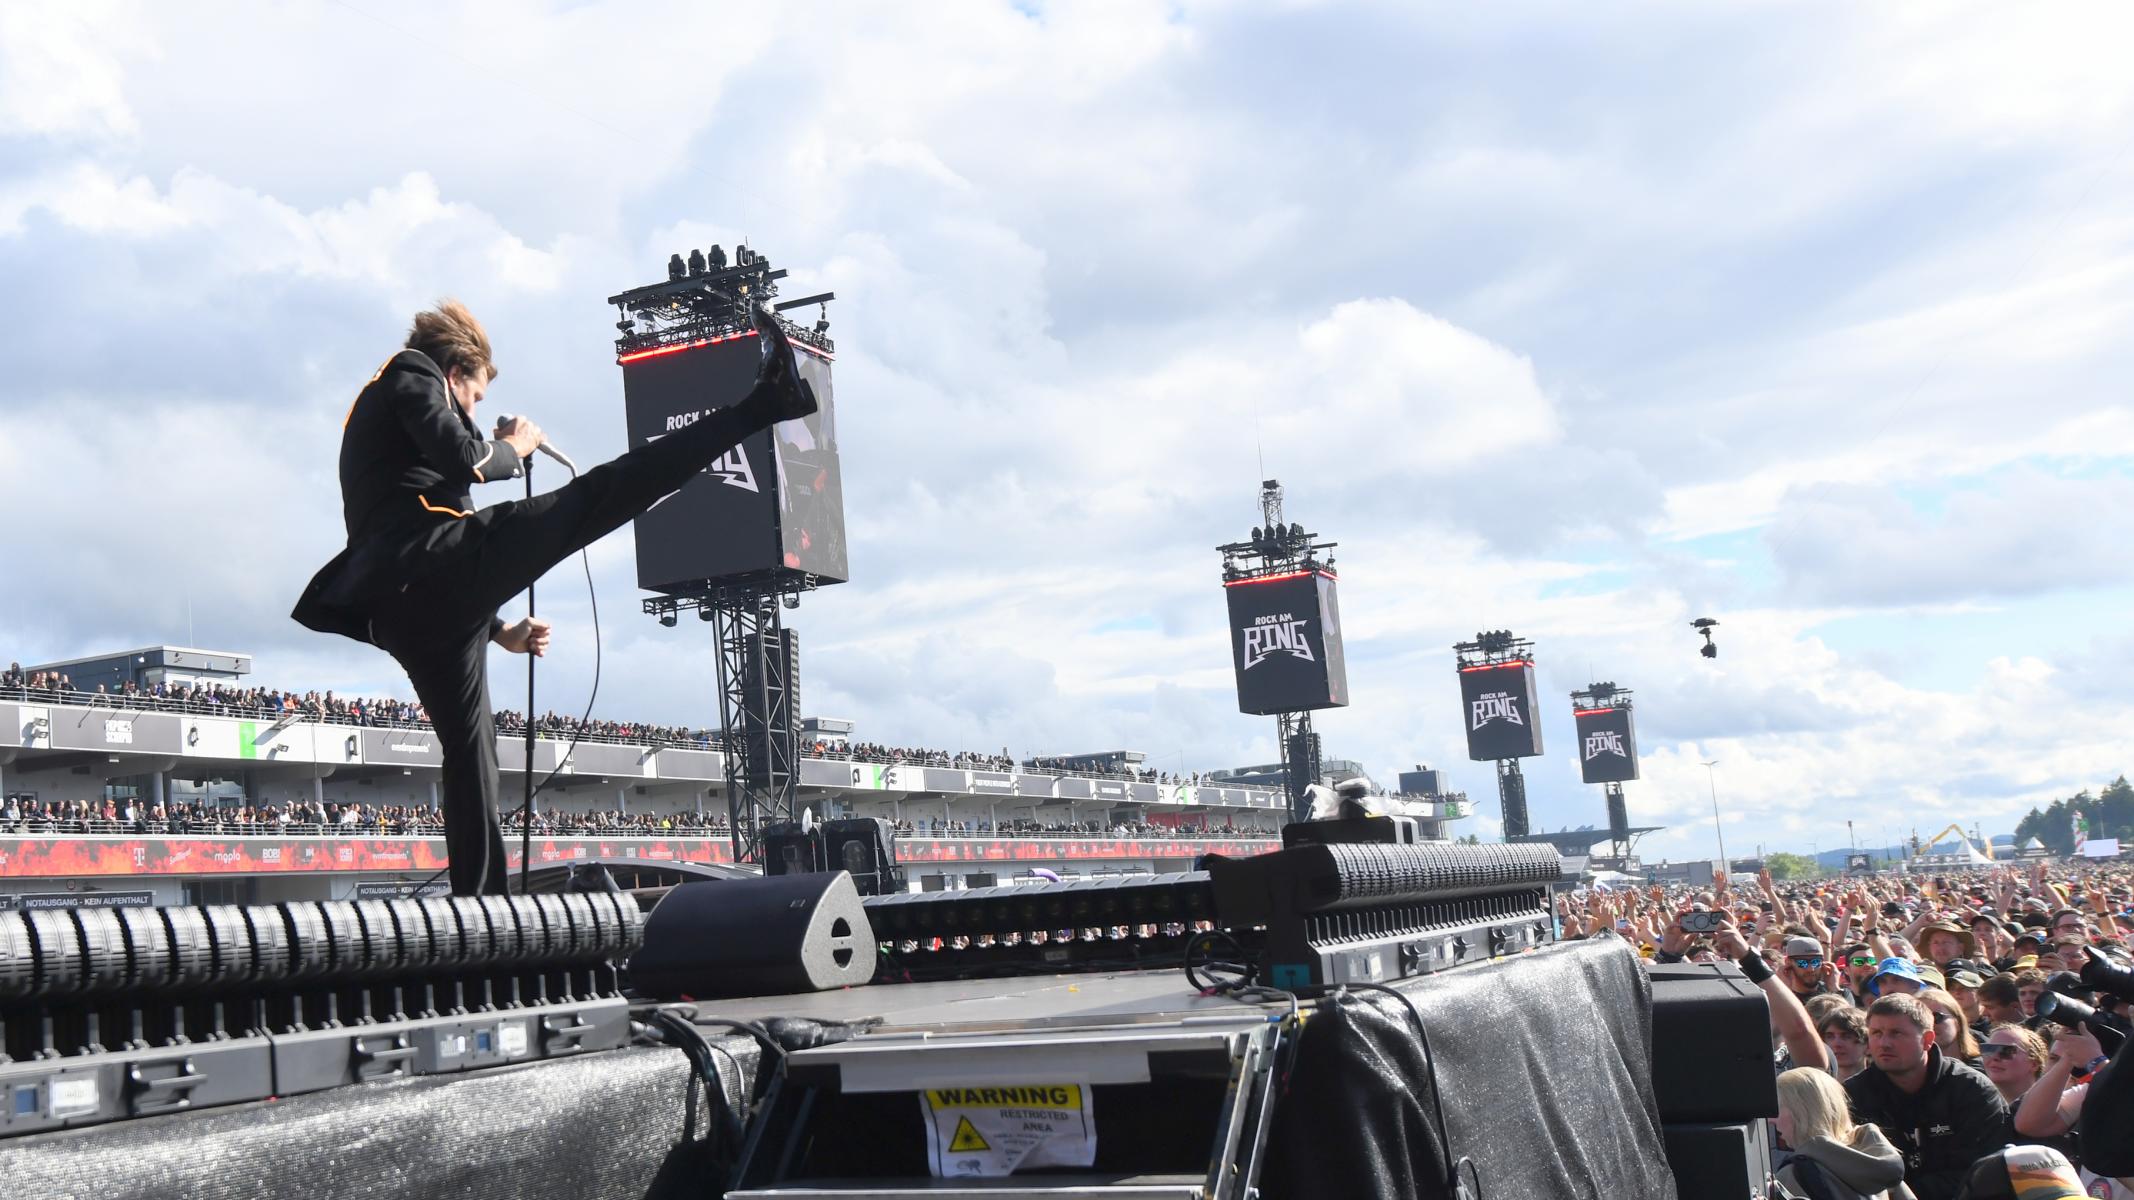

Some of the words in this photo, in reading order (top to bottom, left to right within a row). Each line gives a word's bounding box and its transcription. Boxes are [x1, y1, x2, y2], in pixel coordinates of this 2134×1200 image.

[666, 411, 700, 431] ROCK
[1255, 614, 1277, 625] ROCK
[1279, 613, 1293, 622] AM
[1242, 620, 1315, 670] RING
[1472, 696, 1524, 731] RING
[1585, 734, 1626, 761] RING
[361, 887, 397, 895] NOTAUSGANG
[401, 886, 414, 894] KEIN
[26, 899, 78, 908] NOTAUSGANG
[84, 898, 102, 907] KEIN
[103, 895, 149, 905] AUFENTHALT
[936, 1087, 1069, 1105] WARNING
[1000, 1109, 1069, 1121] RESTRICTED
[1023, 1122, 1054, 1132] AREA
